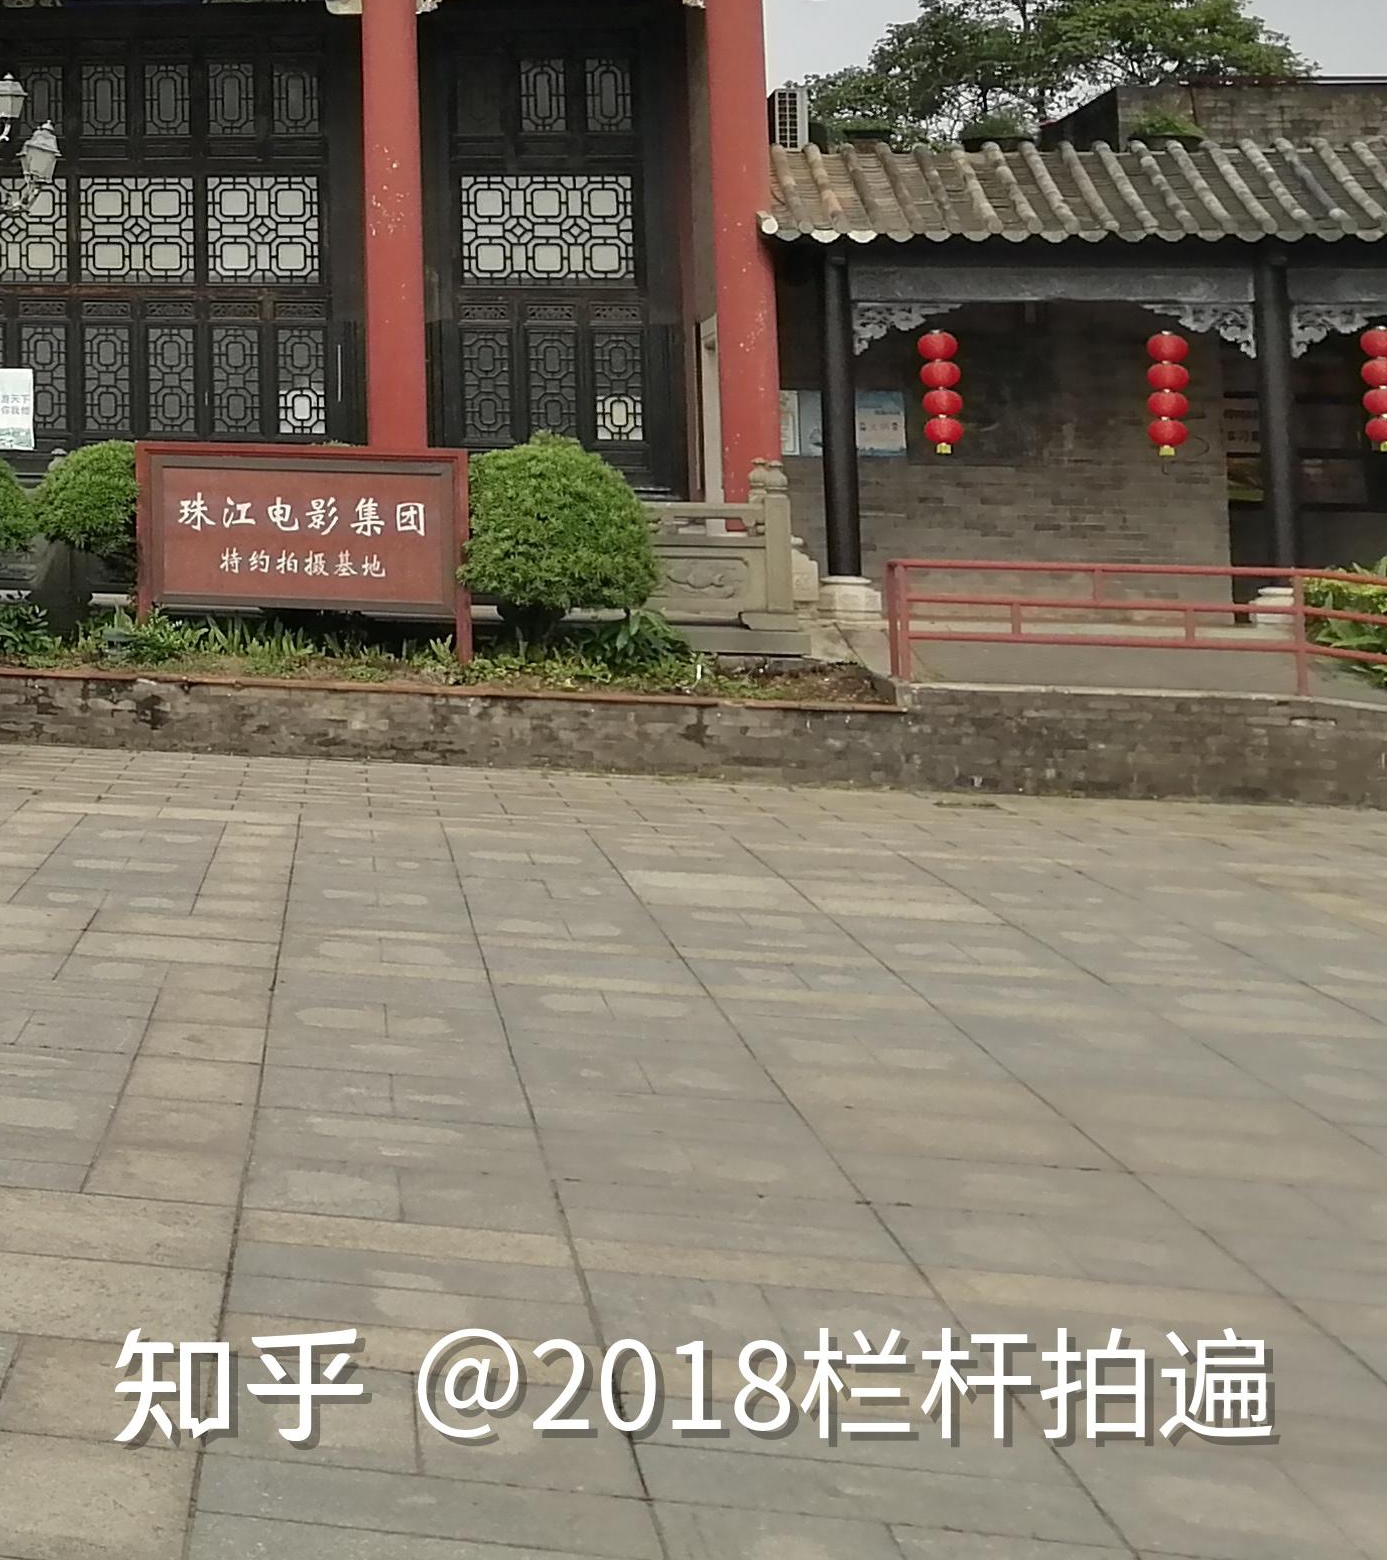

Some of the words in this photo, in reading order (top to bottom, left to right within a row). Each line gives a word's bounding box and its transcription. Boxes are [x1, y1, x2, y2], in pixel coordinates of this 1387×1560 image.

[177, 491, 427, 537] 珠江电影集团
[218, 547, 387, 578] 特约拍摄基地
